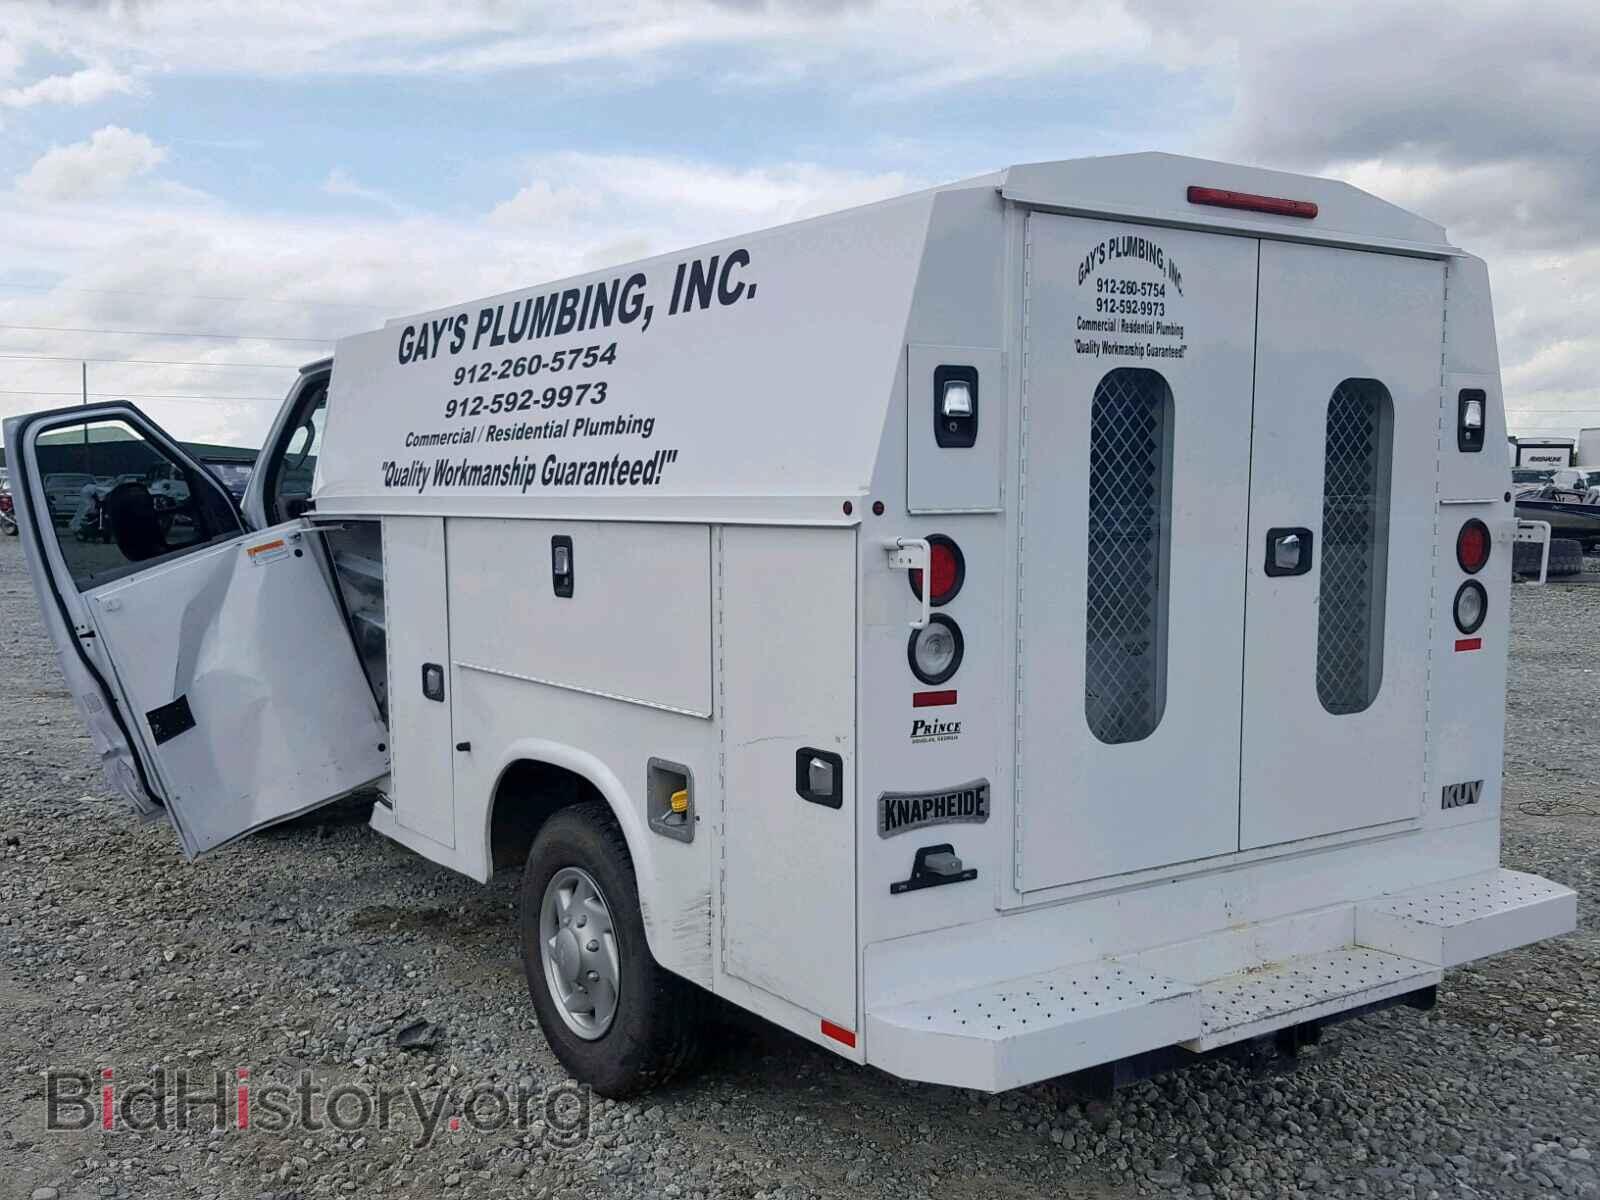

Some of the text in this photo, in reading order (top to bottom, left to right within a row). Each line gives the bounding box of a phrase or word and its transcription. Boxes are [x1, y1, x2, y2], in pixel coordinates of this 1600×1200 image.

[1078, 242, 1105, 286] GAY'S
[1108, 236, 1166, 278] PLUMBING,
[1096, 278, 1165, 298] 912-260-5754
[398, 248, 758, 366] GAY'S PLUMBING, INC.
[1096, 298, 1165, 317] 912-592-9973
[1077, 316, 1116, 332] Commercial
[1121, 319, 1155, 335] Residential
[1156, 321, 1184, 340] Plumbing
[453, 343, 618, 387] 912-260-5754
[1101, 341, 1145, 358] Workmanship
[444, 382, 609, 419] 912-592-9973
[405, 415, 656, 448] Commercial / Residential Plumbing
[381, 449, 678, 494] "Quality Workmanship Guaranteed!"
[884, 787, 985, 832] KNAPHEIDE
[1441, 779, 1485, 810] KUV
